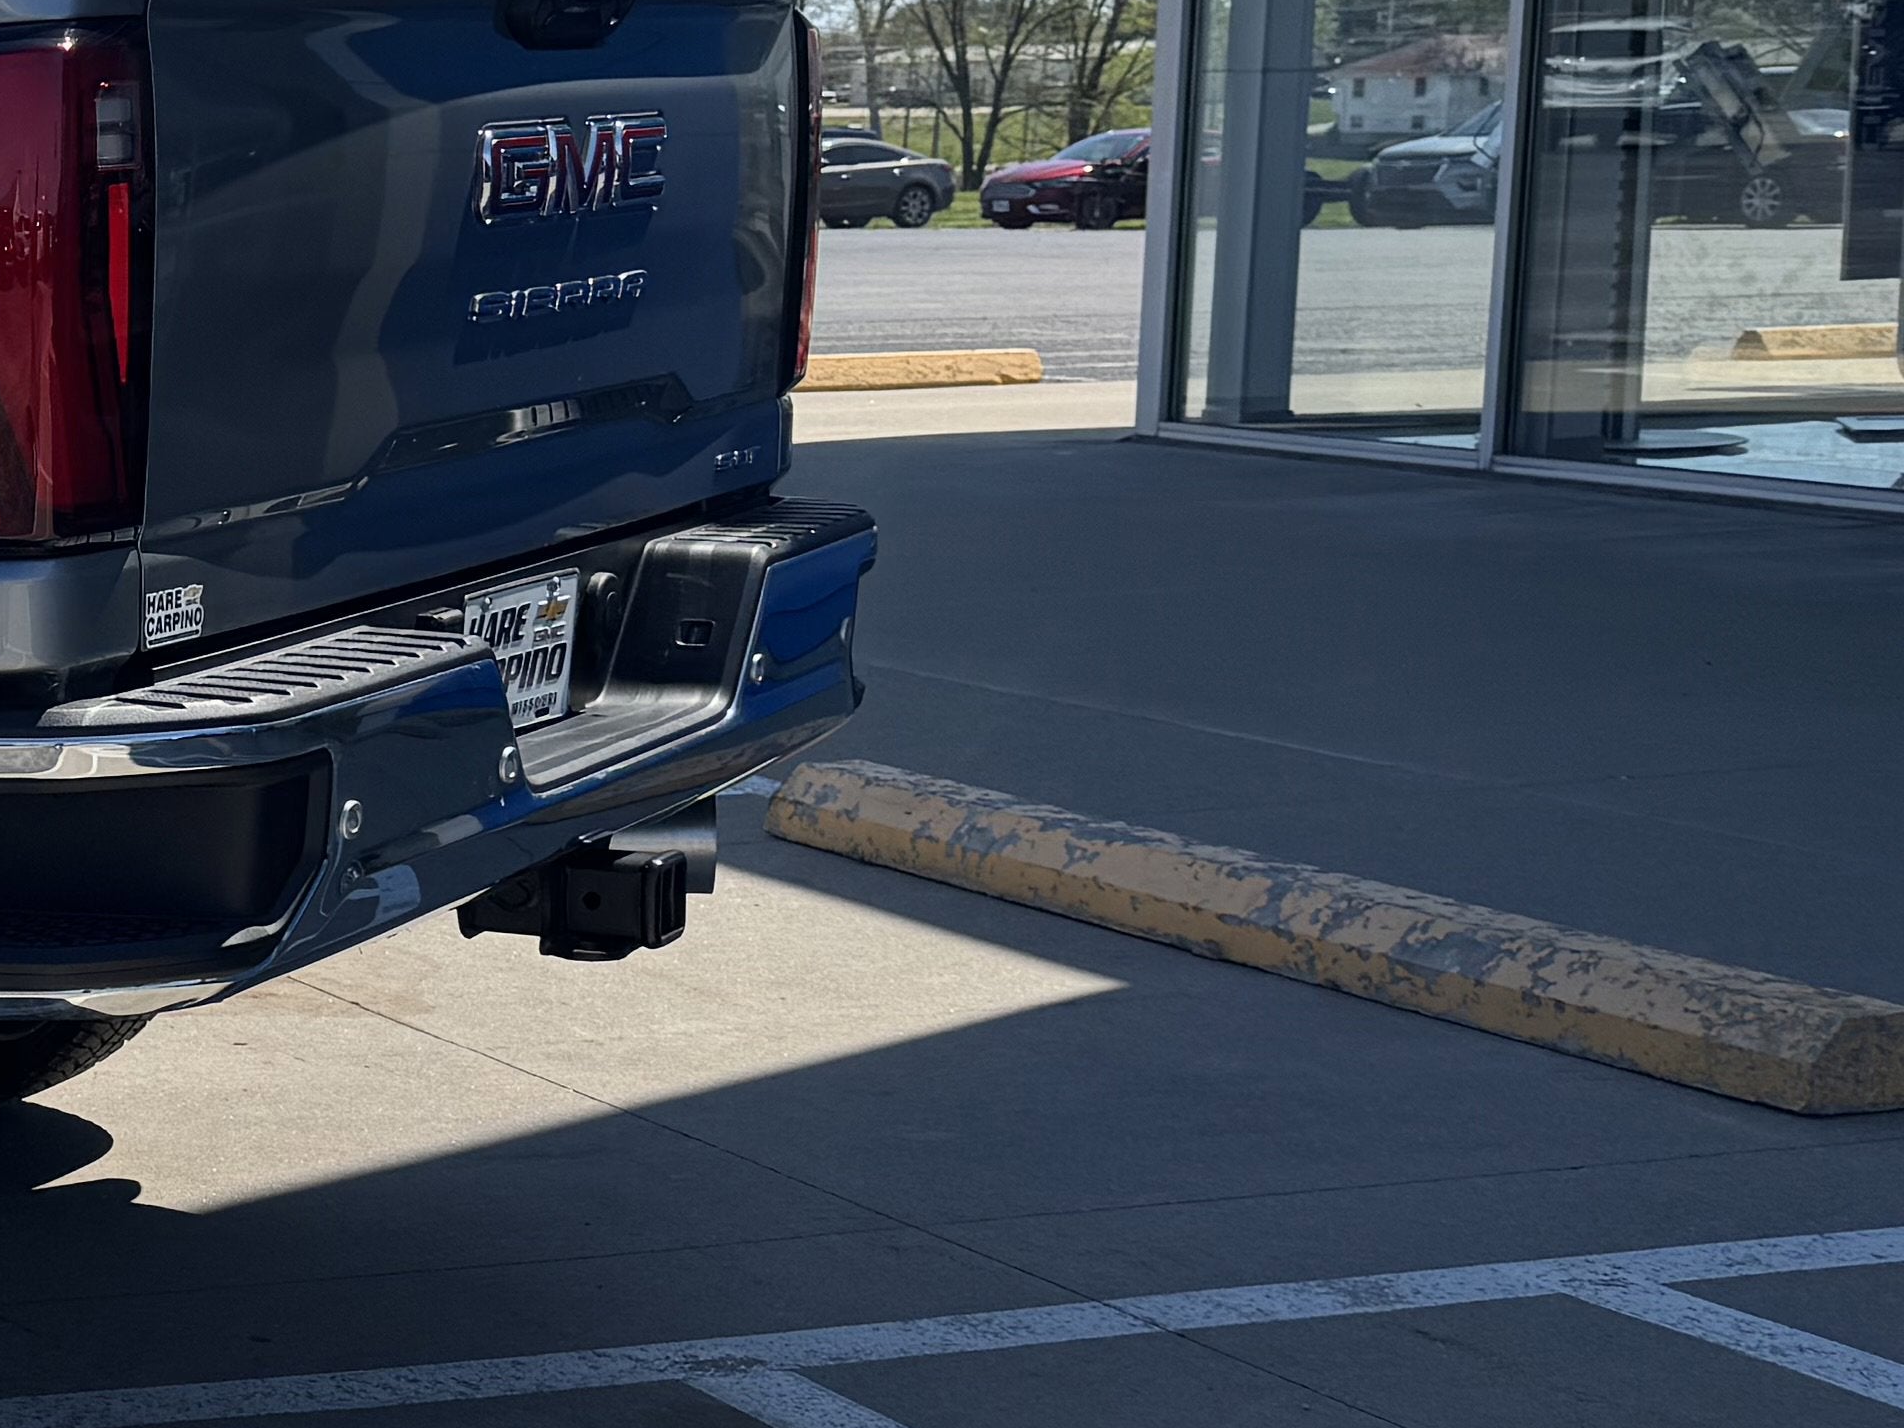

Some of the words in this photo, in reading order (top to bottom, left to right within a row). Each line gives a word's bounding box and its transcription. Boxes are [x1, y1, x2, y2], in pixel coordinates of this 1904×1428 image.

[472, 110, 667, 225] GMC
[468, 269, 648, 323] SIERRA
[146, 606, 202, 638] CARPINO
[147, 589, 183, 616] HARE
[469, 602, 532, 649] HARE
[511, 691, 558, 716] MISSOURI
